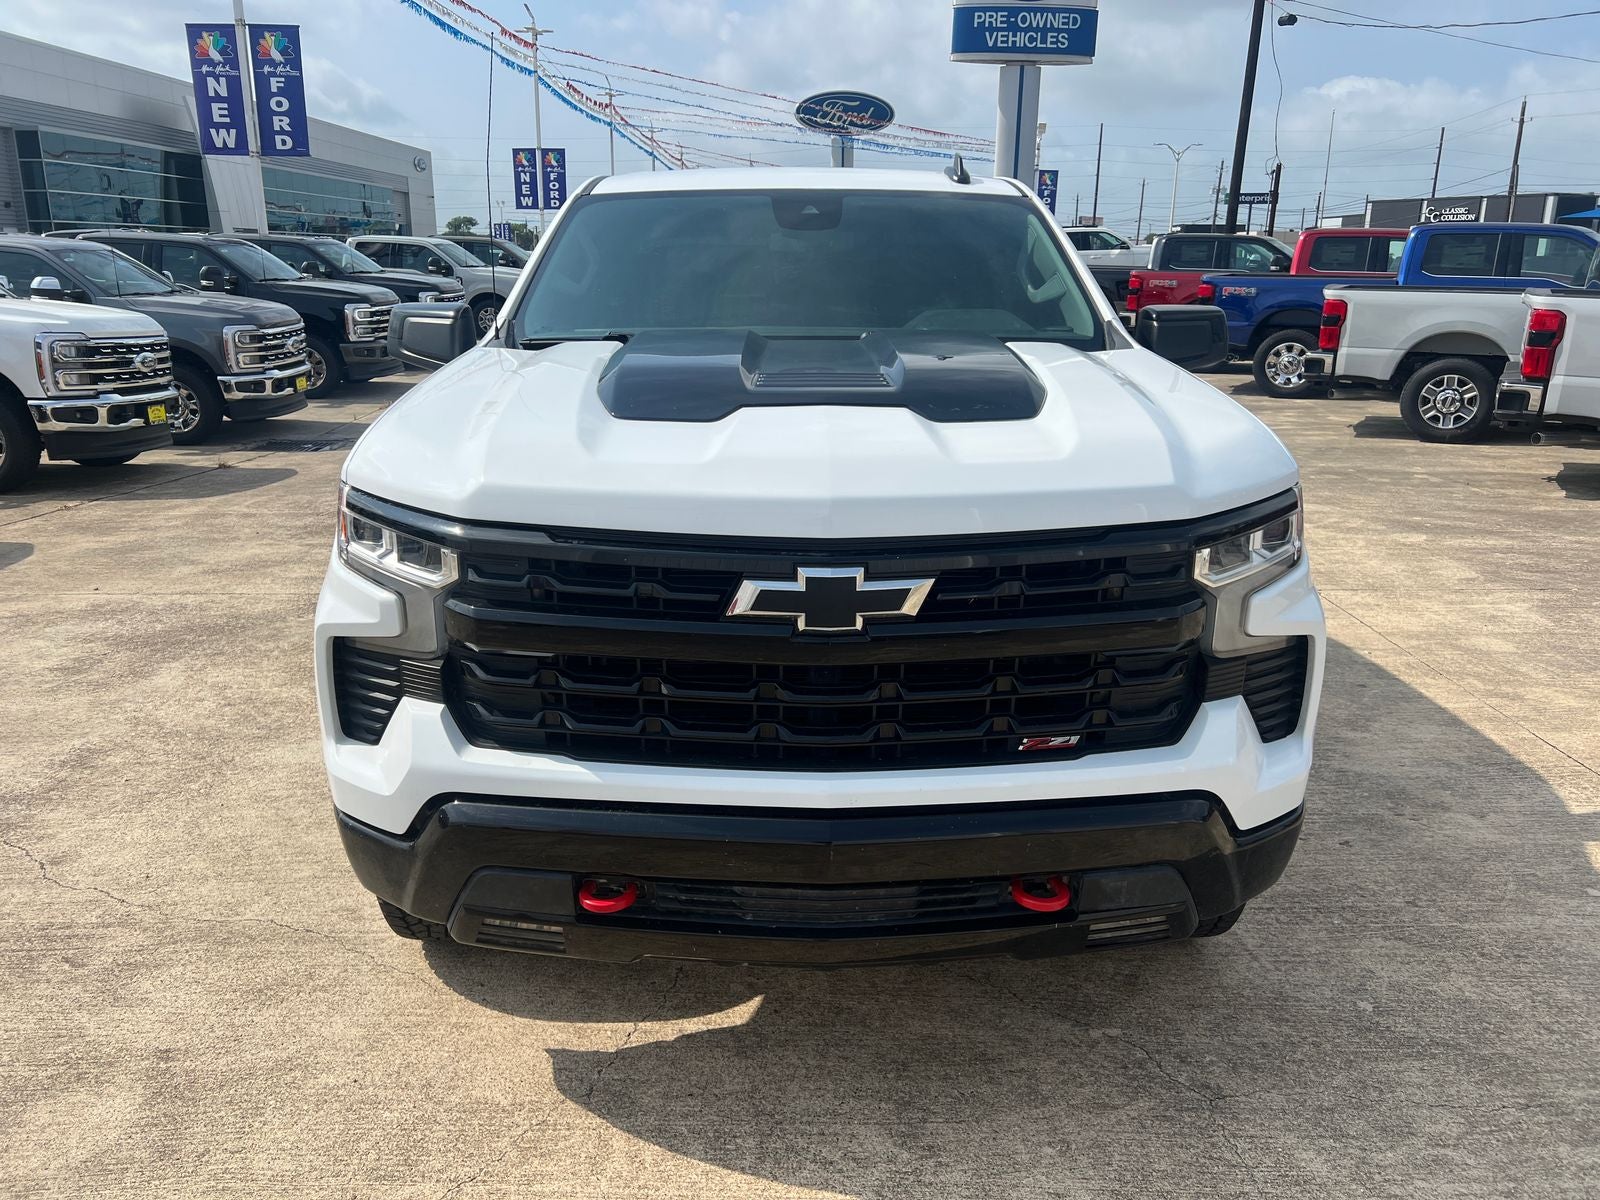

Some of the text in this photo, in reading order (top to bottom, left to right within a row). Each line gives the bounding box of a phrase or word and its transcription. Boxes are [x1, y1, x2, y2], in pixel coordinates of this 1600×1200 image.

[973, 11, 1081, 29] PRE-OWNED
[985, 31, 1069, 48] VEHICLES
[206, 76, 237, 149] NEW
[269, 77, 293, 150] FORD
[816, 99, 875, 127] Ford
[520, 172, 533, 207] NEW
[549, 172, 560, 207] FORD
[1042, 189, 1051, 209] FO
[1440, 213, 1476, 221] COLLISION
[1018, 736, 1080, 750] Z71
